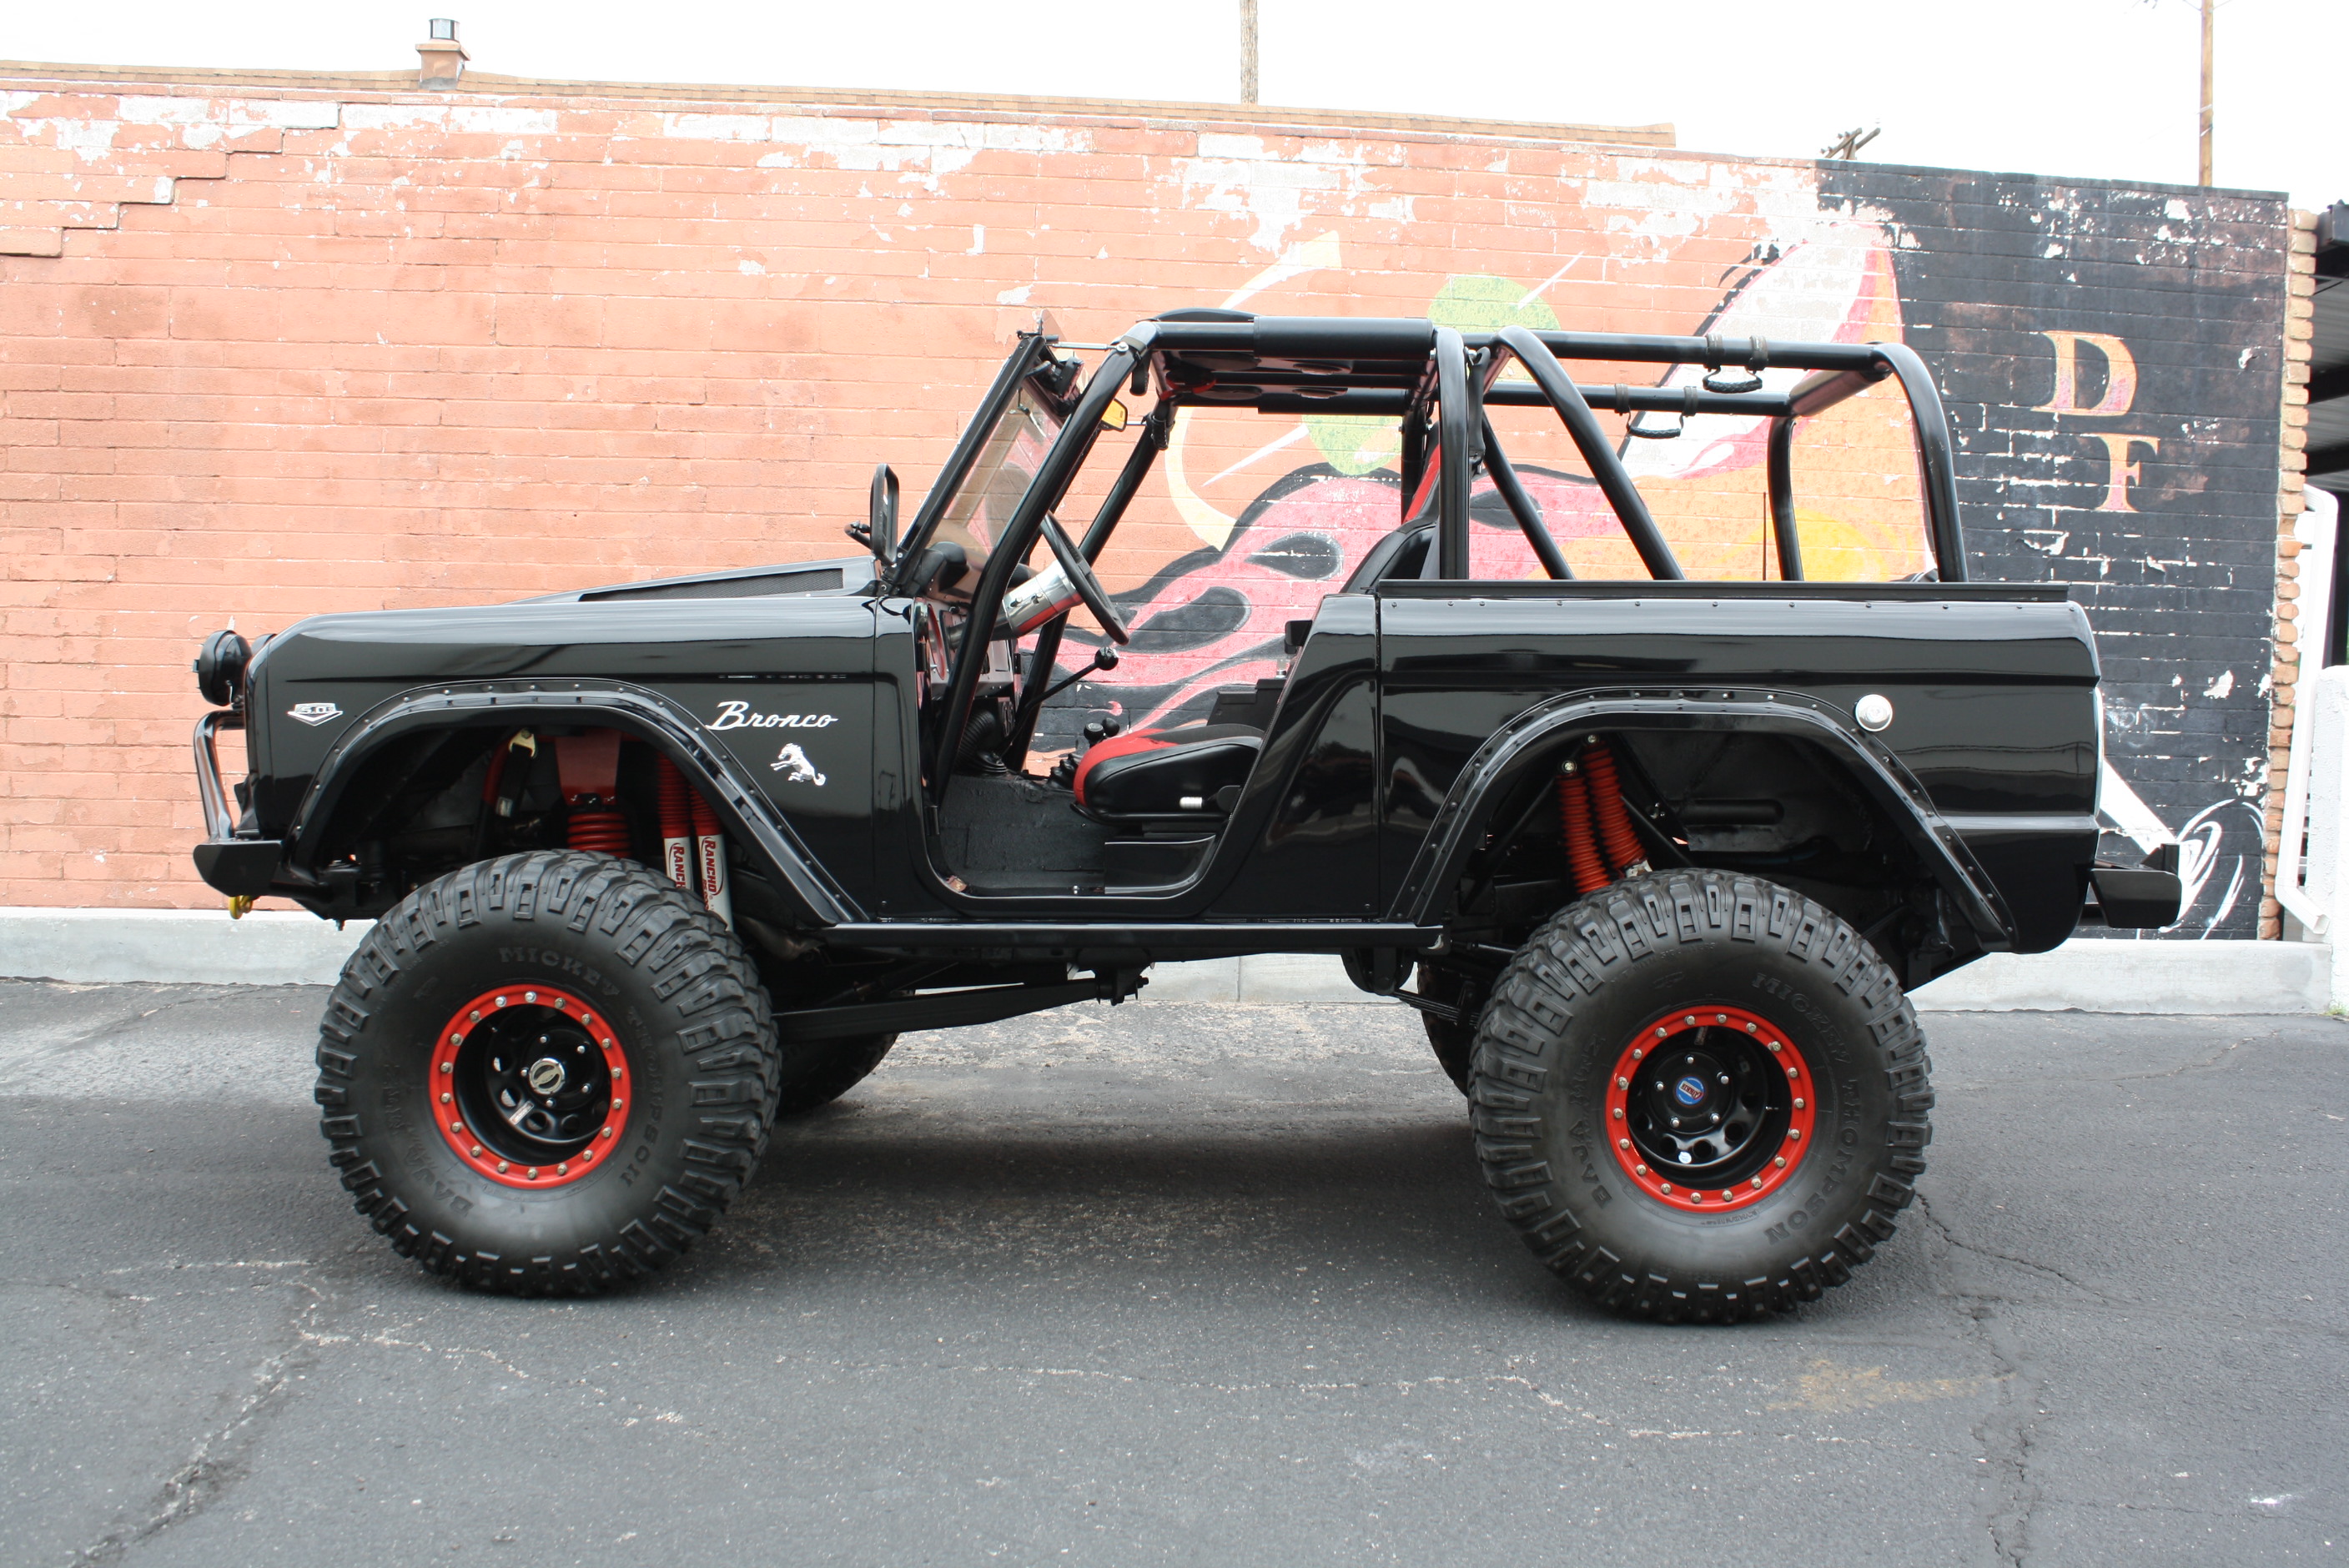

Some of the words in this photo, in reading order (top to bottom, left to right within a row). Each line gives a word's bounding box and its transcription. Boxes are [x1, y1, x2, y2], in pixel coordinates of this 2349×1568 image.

[2030, 330, 2138, 416] D
[2095, 433, 2160, 513] F
[704, 701, 839, 731] Bronco
[672, 845, 687, 889] RANCH
[704, 839, 717, 893] RANCHO
[1752, 972, 1852, 1065] MICKEY
[499, 947, 620, 997] MICKEY
[619, 1006, 664, 1188] THOMPSON
[405, 1143, 474, 1218] BAJA
[1568, 1120, 1613, 1209] BAJA
[1764, 1079, 1862, 1245] THOMPSON
